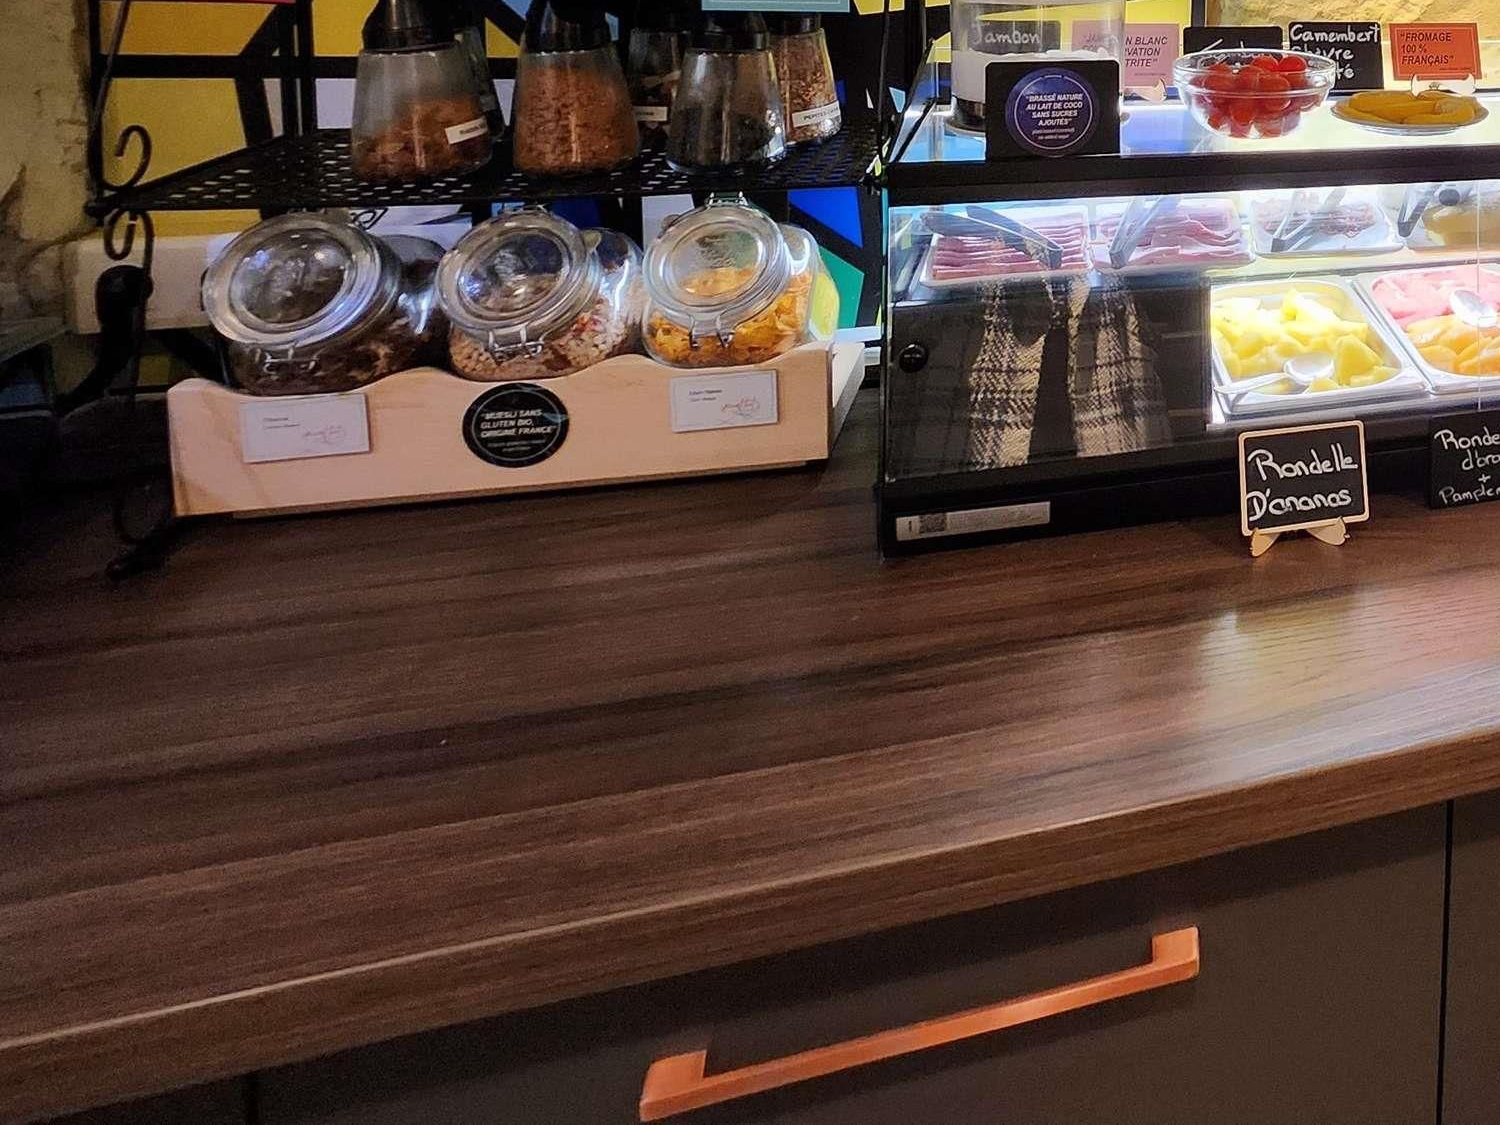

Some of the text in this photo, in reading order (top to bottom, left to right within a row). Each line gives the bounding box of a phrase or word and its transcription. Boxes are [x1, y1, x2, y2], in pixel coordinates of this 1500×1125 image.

[1289, 24, 1381, 44] Camembert
[1135, 35, 1168, 46] BLANC
[1401, 43, 1428, 54] 100 %
[1057, 93, 1083, 102] NATURE
[1025, 101, 1083, 111] AU LAIT DE COCO
[1032, 111, 1050, 119] SANS
[480, 419, 516, 430] GLUTEN
[1248, 442, 1358, 481] Rondelle
[1478, 473, 1491, 483] +
[1246, 488, 1352, 522] D'ananas
